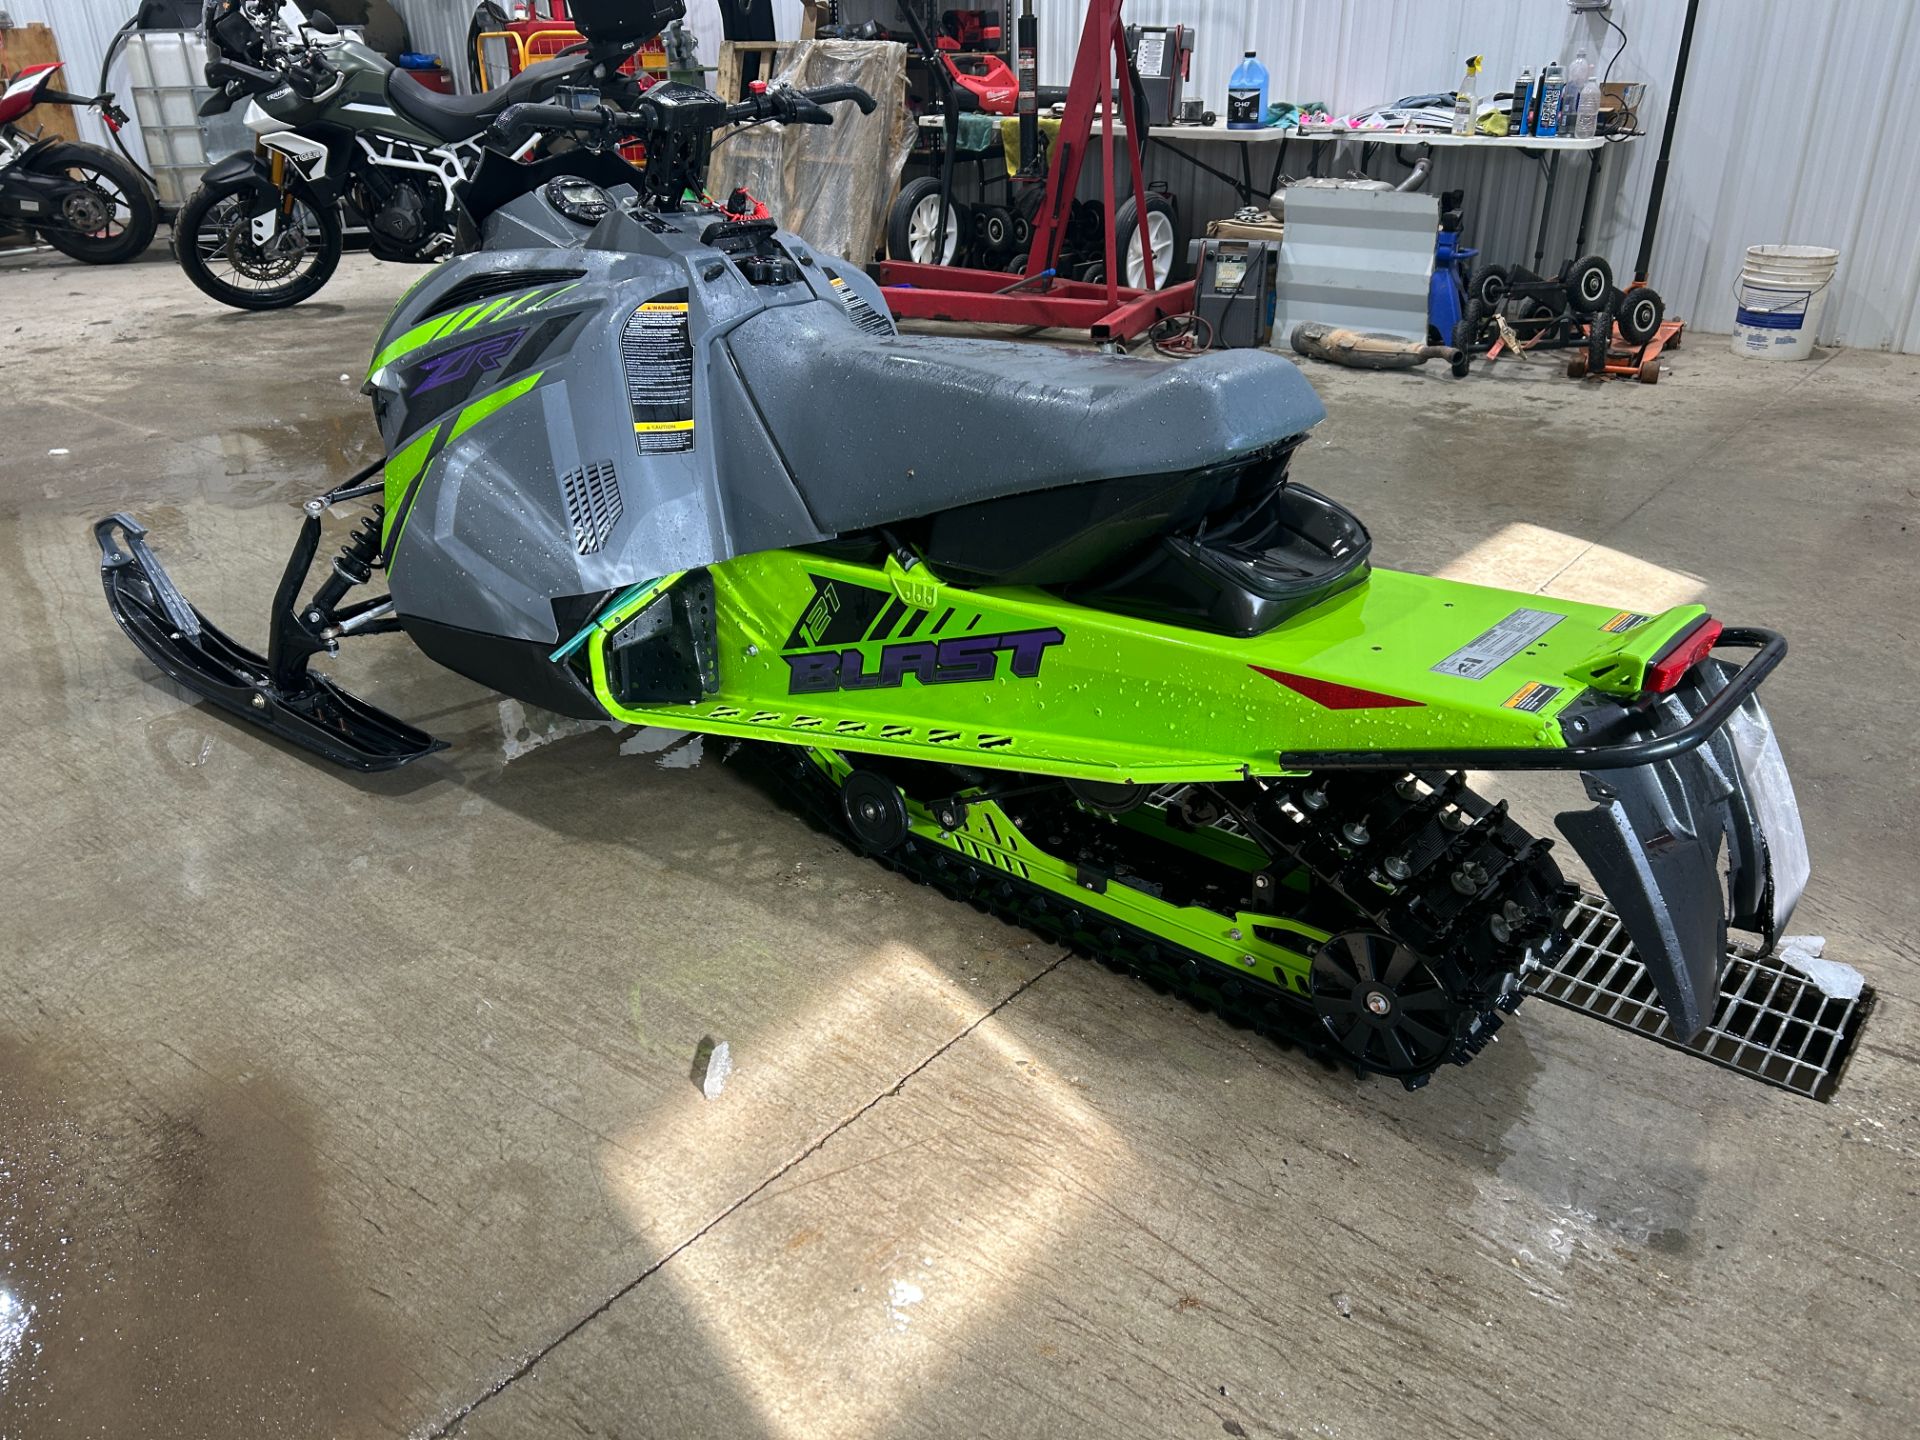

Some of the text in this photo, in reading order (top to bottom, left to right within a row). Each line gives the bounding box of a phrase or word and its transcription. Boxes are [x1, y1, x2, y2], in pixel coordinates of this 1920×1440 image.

[292, 150, 322, 162] TIGER
[408, 329, 526, 399] ZR
[780, 626, 1065, 695] BLAST
